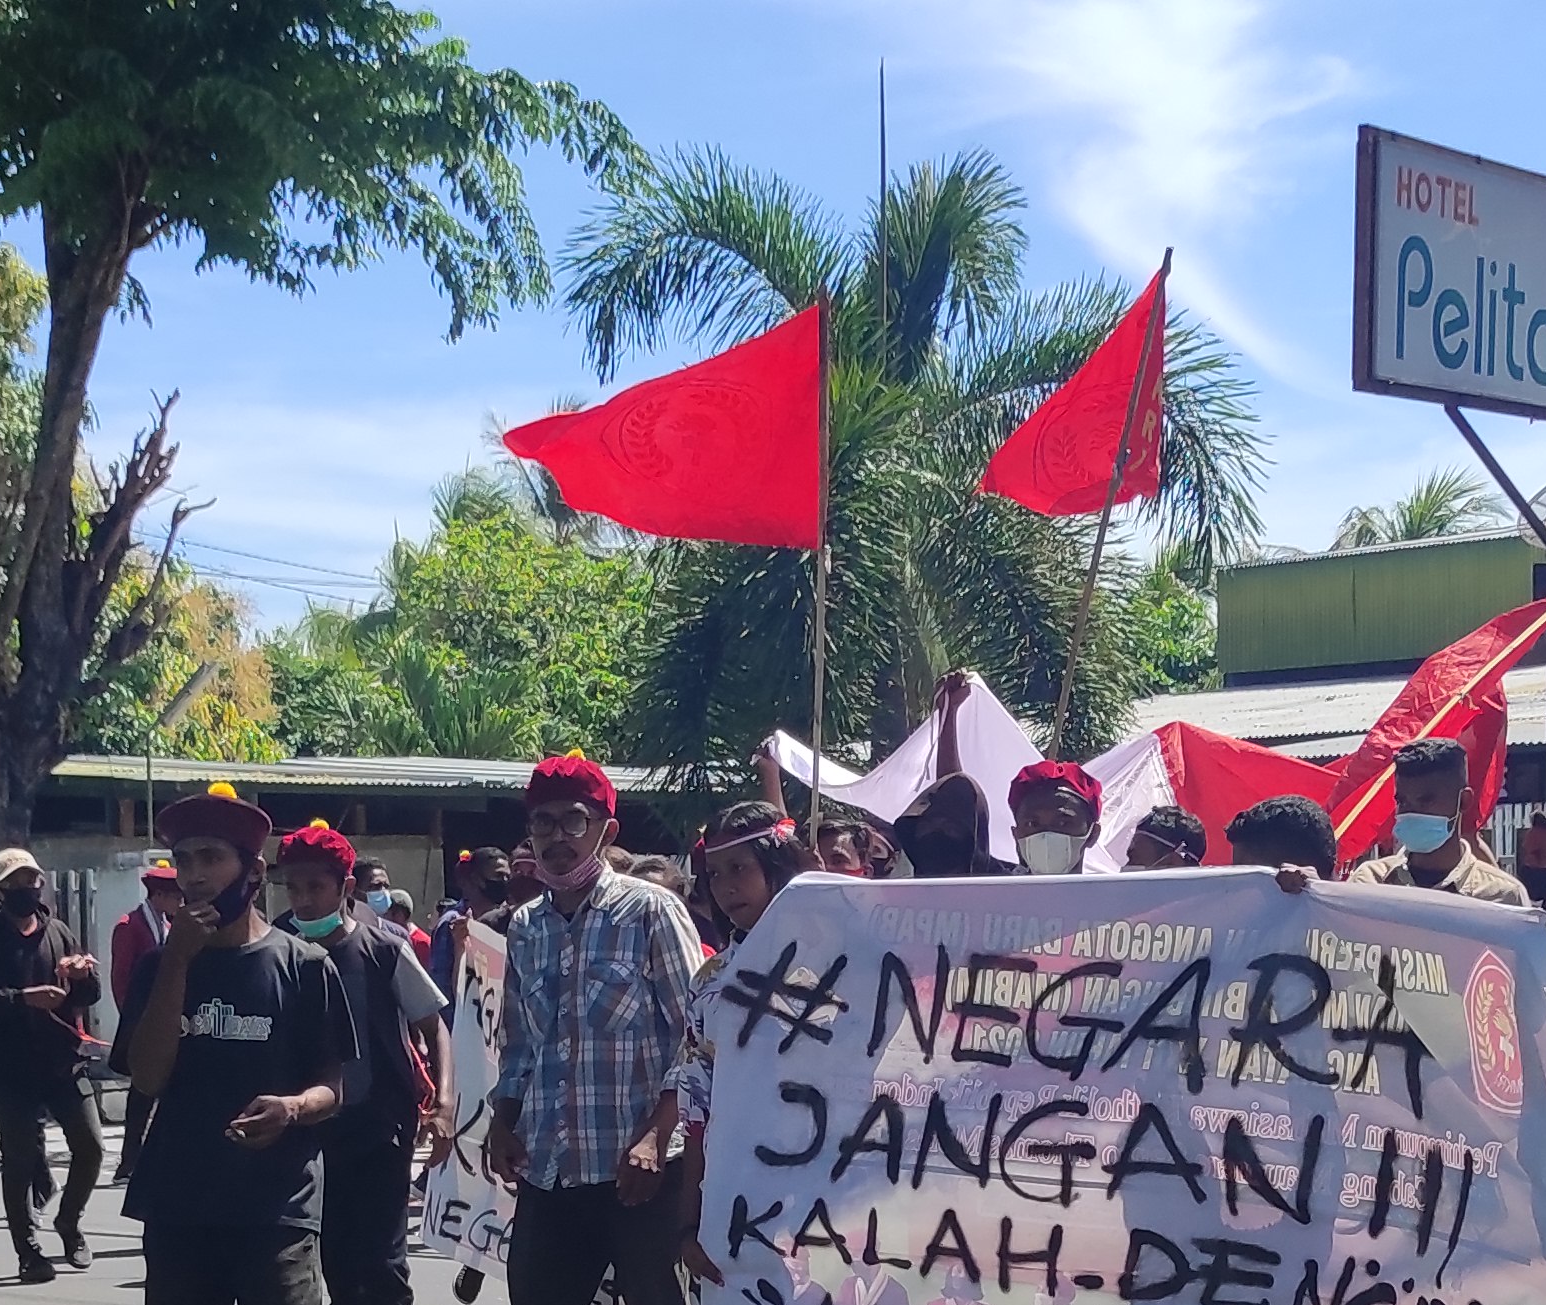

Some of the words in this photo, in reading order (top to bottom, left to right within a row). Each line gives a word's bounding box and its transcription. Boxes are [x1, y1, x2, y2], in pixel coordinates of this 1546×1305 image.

[1396, 165, 1480, 226] HOTEL
[719, 939, 1437, 1120] #NEGARA
[753, 1080, 1323, 1226] JANGAN
